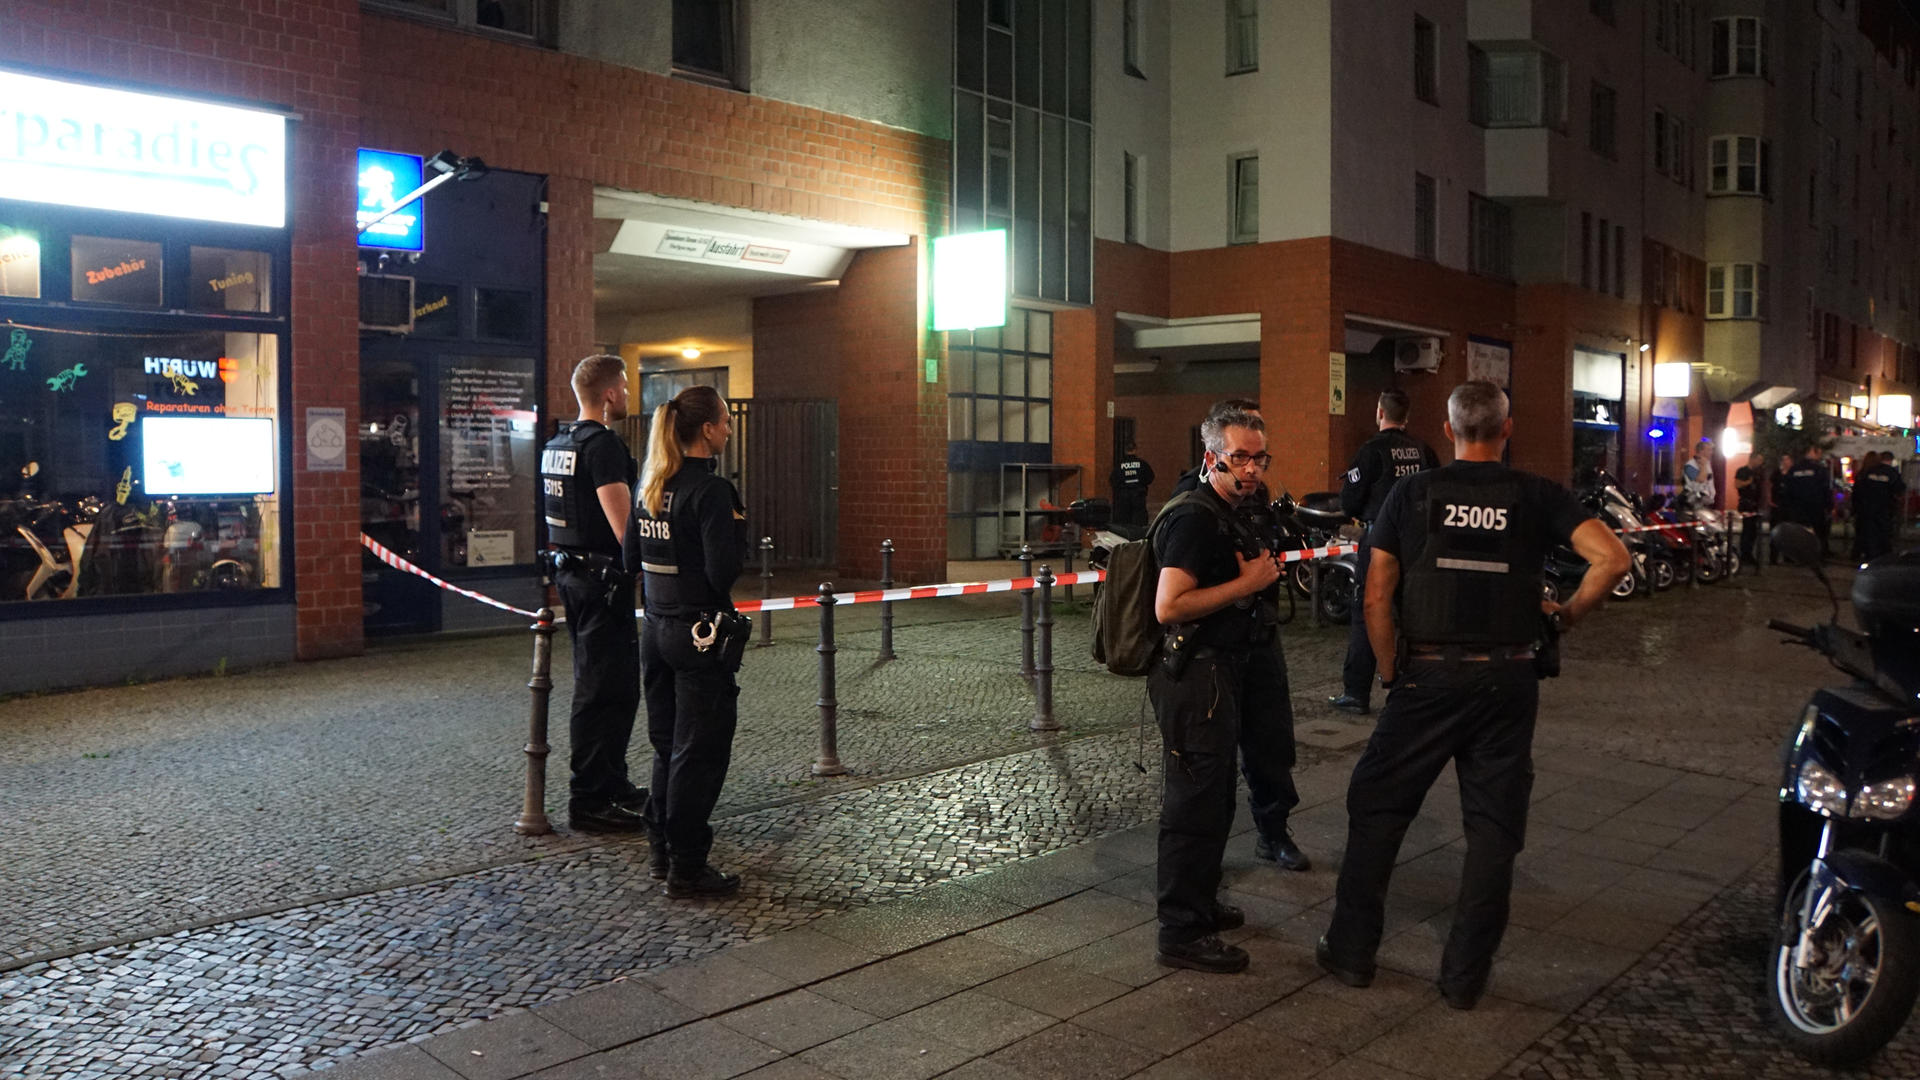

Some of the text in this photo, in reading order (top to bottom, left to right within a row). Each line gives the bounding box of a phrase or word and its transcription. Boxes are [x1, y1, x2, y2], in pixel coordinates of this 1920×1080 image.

[708, 240, 745, 256] Ausfahrt
[86, 257, 146, 285] Zubehör
[208, 270, 254, 293] Tuning
[412, 295, 448, 320] erkauf
[146, 400, 211, 414] Reparaturen
[1390, 447, 1420, 460] POLIZEI
[1394, 464, 1420, 477] 25117
[1443, 503, 1508, 531] 25005
[637, 518, 671, 540] 25118
